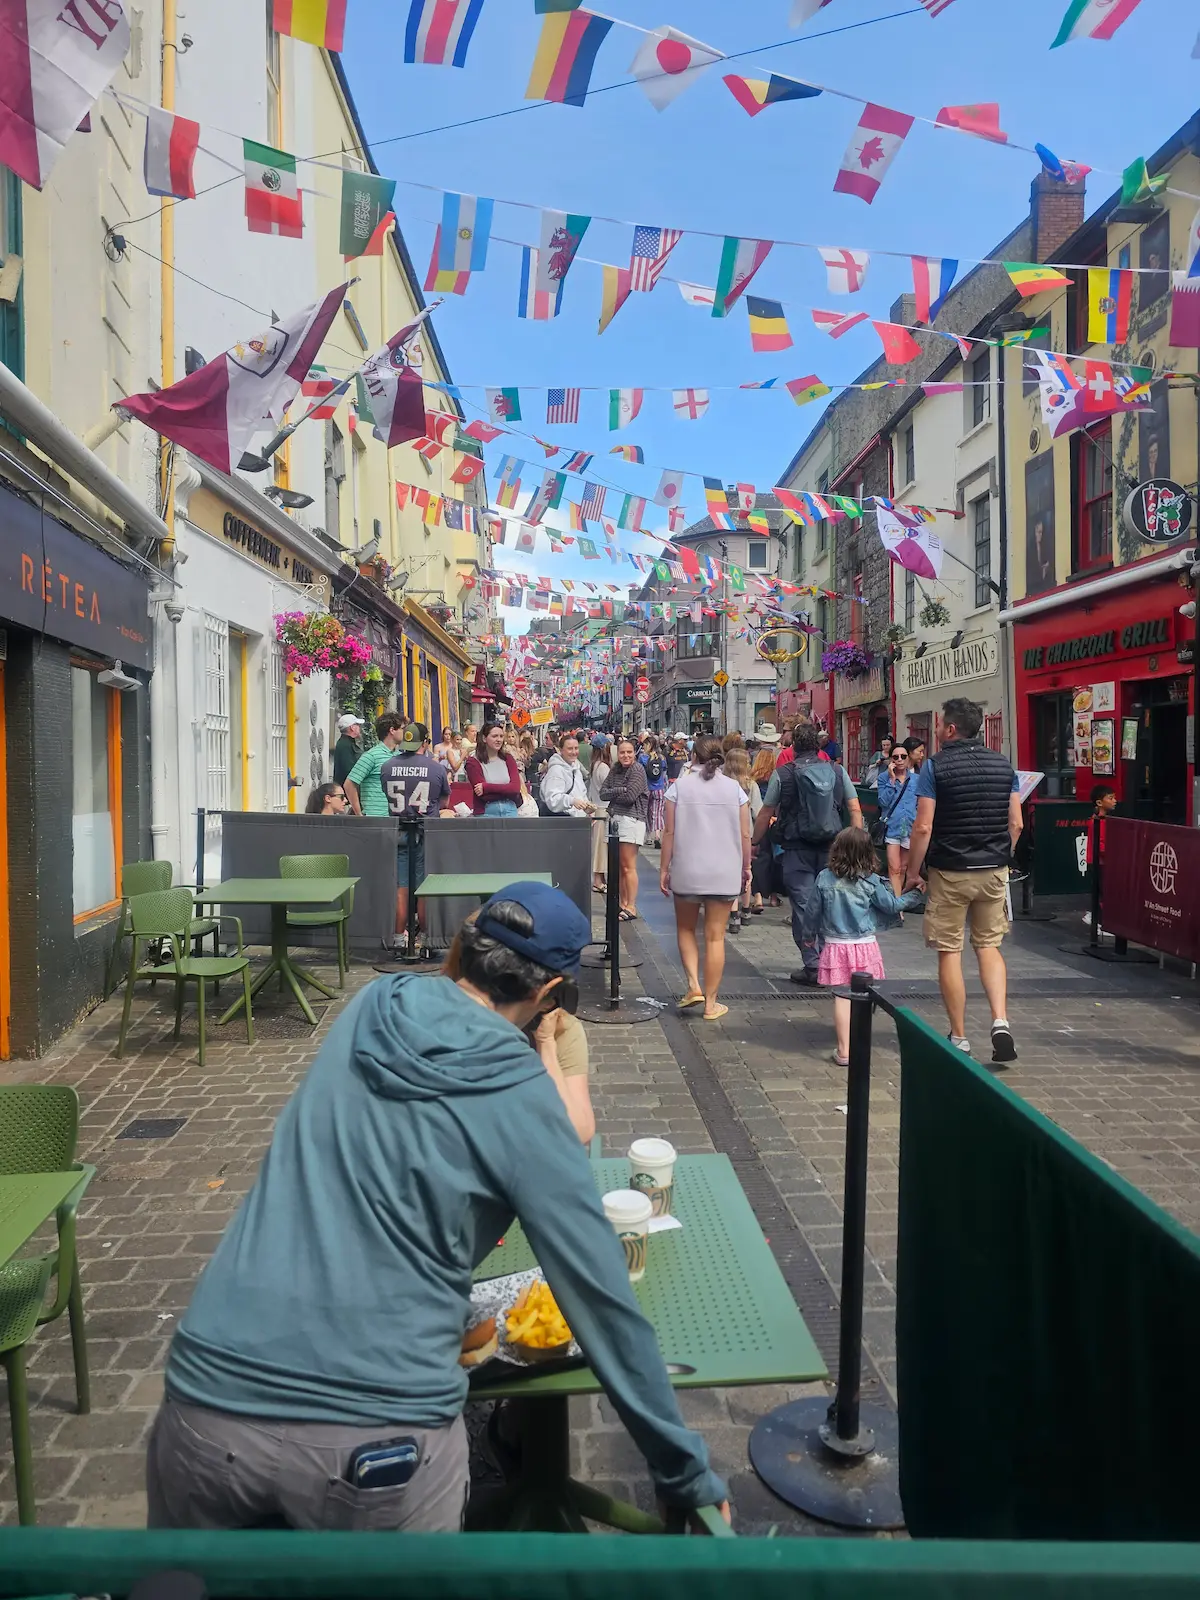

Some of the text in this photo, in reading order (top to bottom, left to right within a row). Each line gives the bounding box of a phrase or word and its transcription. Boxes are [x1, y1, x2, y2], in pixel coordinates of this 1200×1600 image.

[907, 656, 937, 689] HEART
[939, 651, 951, 681] IN
[953, 641, 989, 678] HANDS
[1023, 618, 1169, 671] THE CHARCOAL GRILL
[391, 766, 428, 778] BRUSCHI
[386, 780, 430, 814] 54
